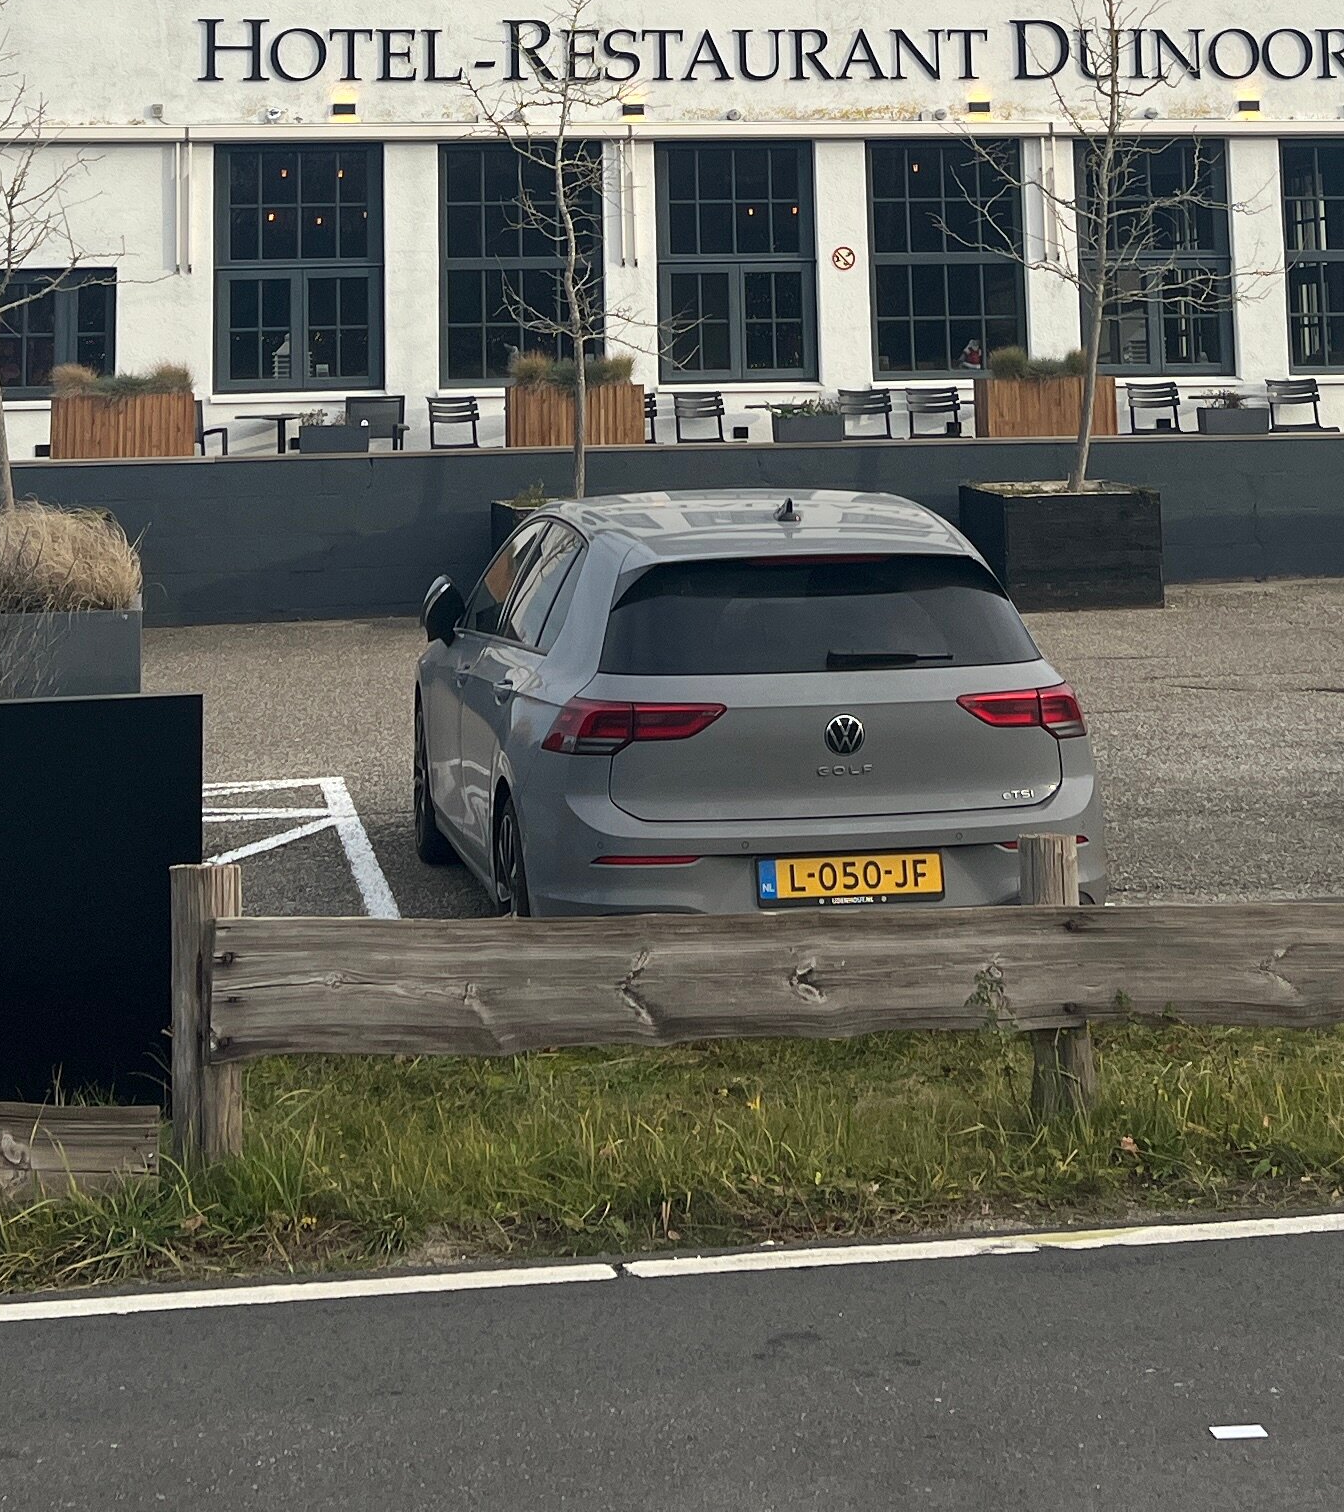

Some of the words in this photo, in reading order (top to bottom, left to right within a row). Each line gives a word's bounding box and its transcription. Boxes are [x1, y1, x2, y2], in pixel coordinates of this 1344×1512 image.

[197, 17, 988, 83] HOTEL-RESTAURANT
[817, 763, 873, 777] GOLF
[762, 882, 776, 893] NL
[788, 858, 928, 893] L-050-JF
